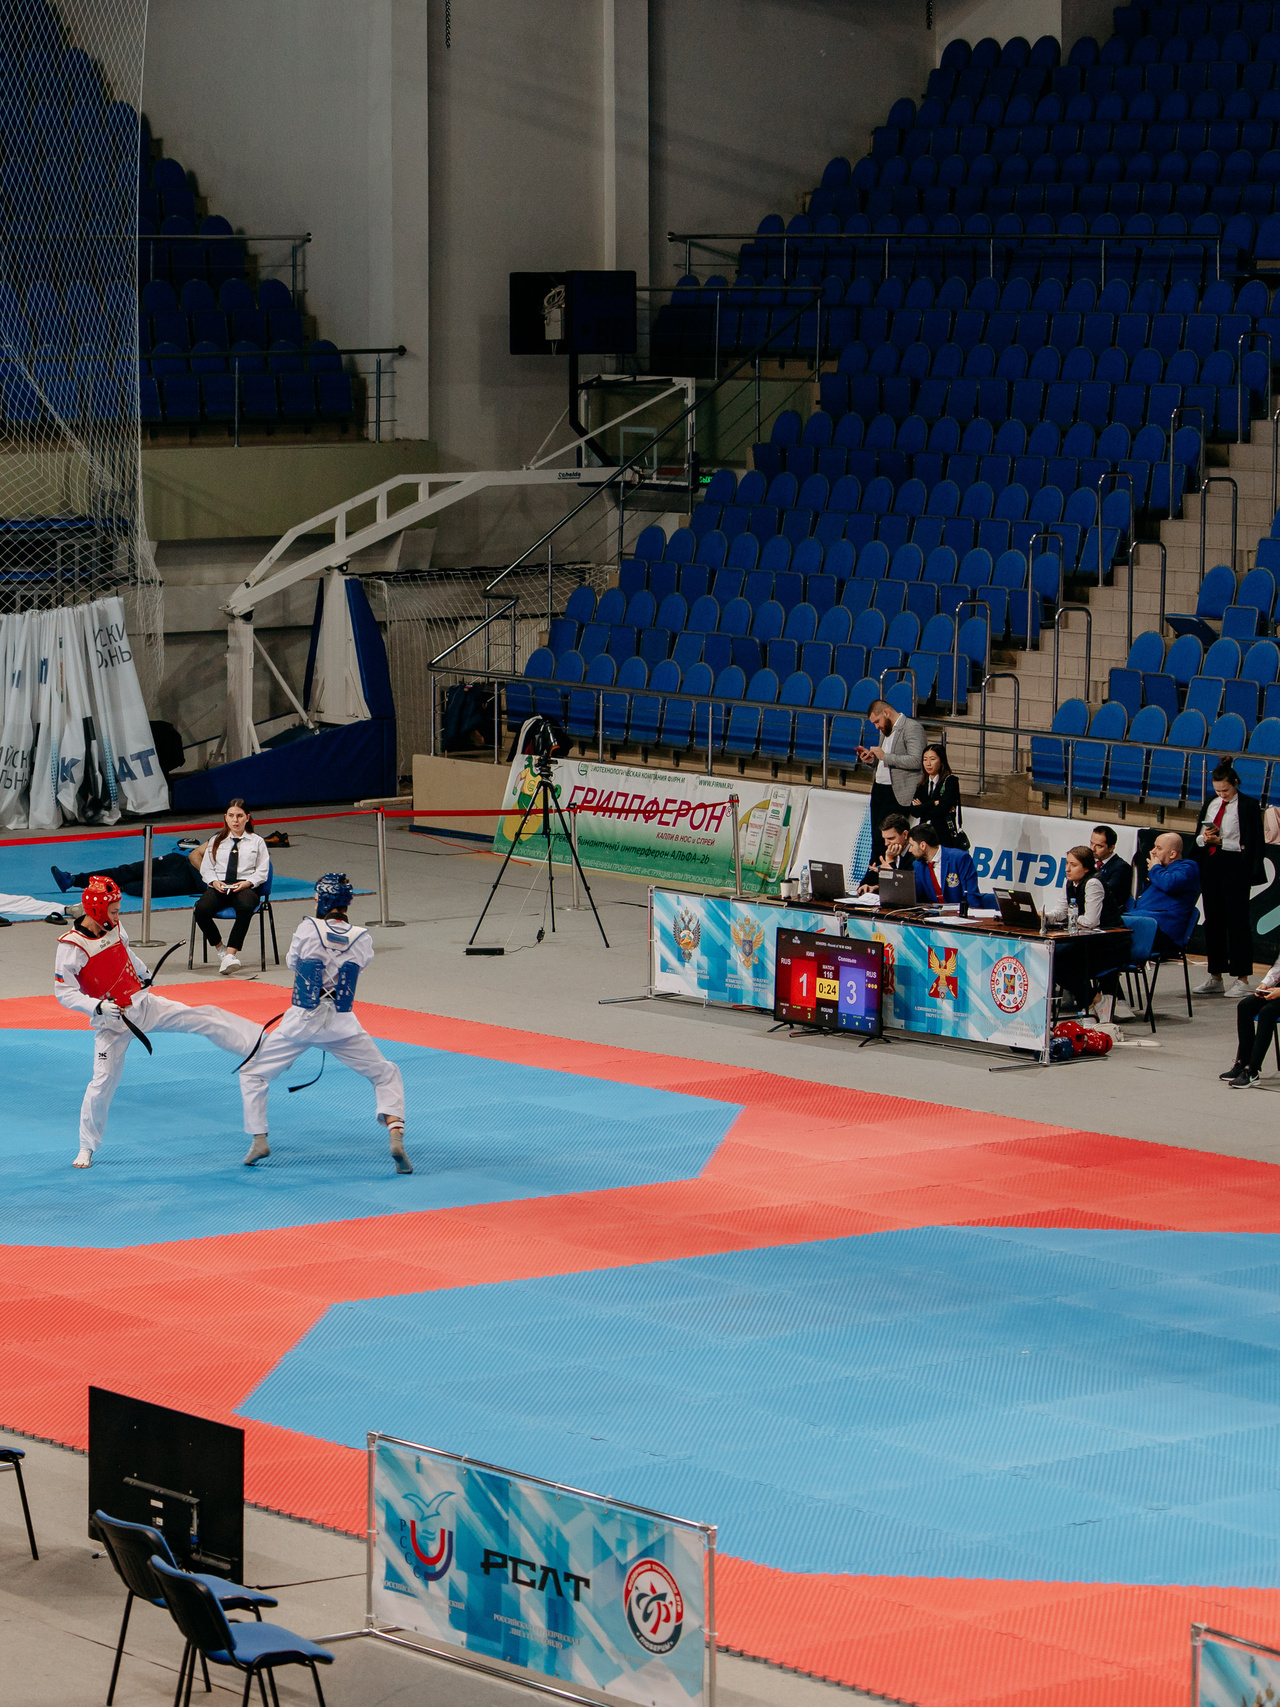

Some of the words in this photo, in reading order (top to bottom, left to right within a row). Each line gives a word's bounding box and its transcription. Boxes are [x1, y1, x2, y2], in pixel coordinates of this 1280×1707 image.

[553, 834, 620, 851] Рекбинантный
[620, 844, 670, 858] интерферон
[656, 832, 675, 842] КАПЛИ
[679, 835, 692, 843] НОС
[696, 837, 715, 846] СПРЕЙ
[781, 957, 791, 965] RUS
[866, 970, 877, 979] RUS
[799, 973, 807, 997] 1
[818, 983, 836, 995] 0:24
[846, 980, 857, 1005] 3
